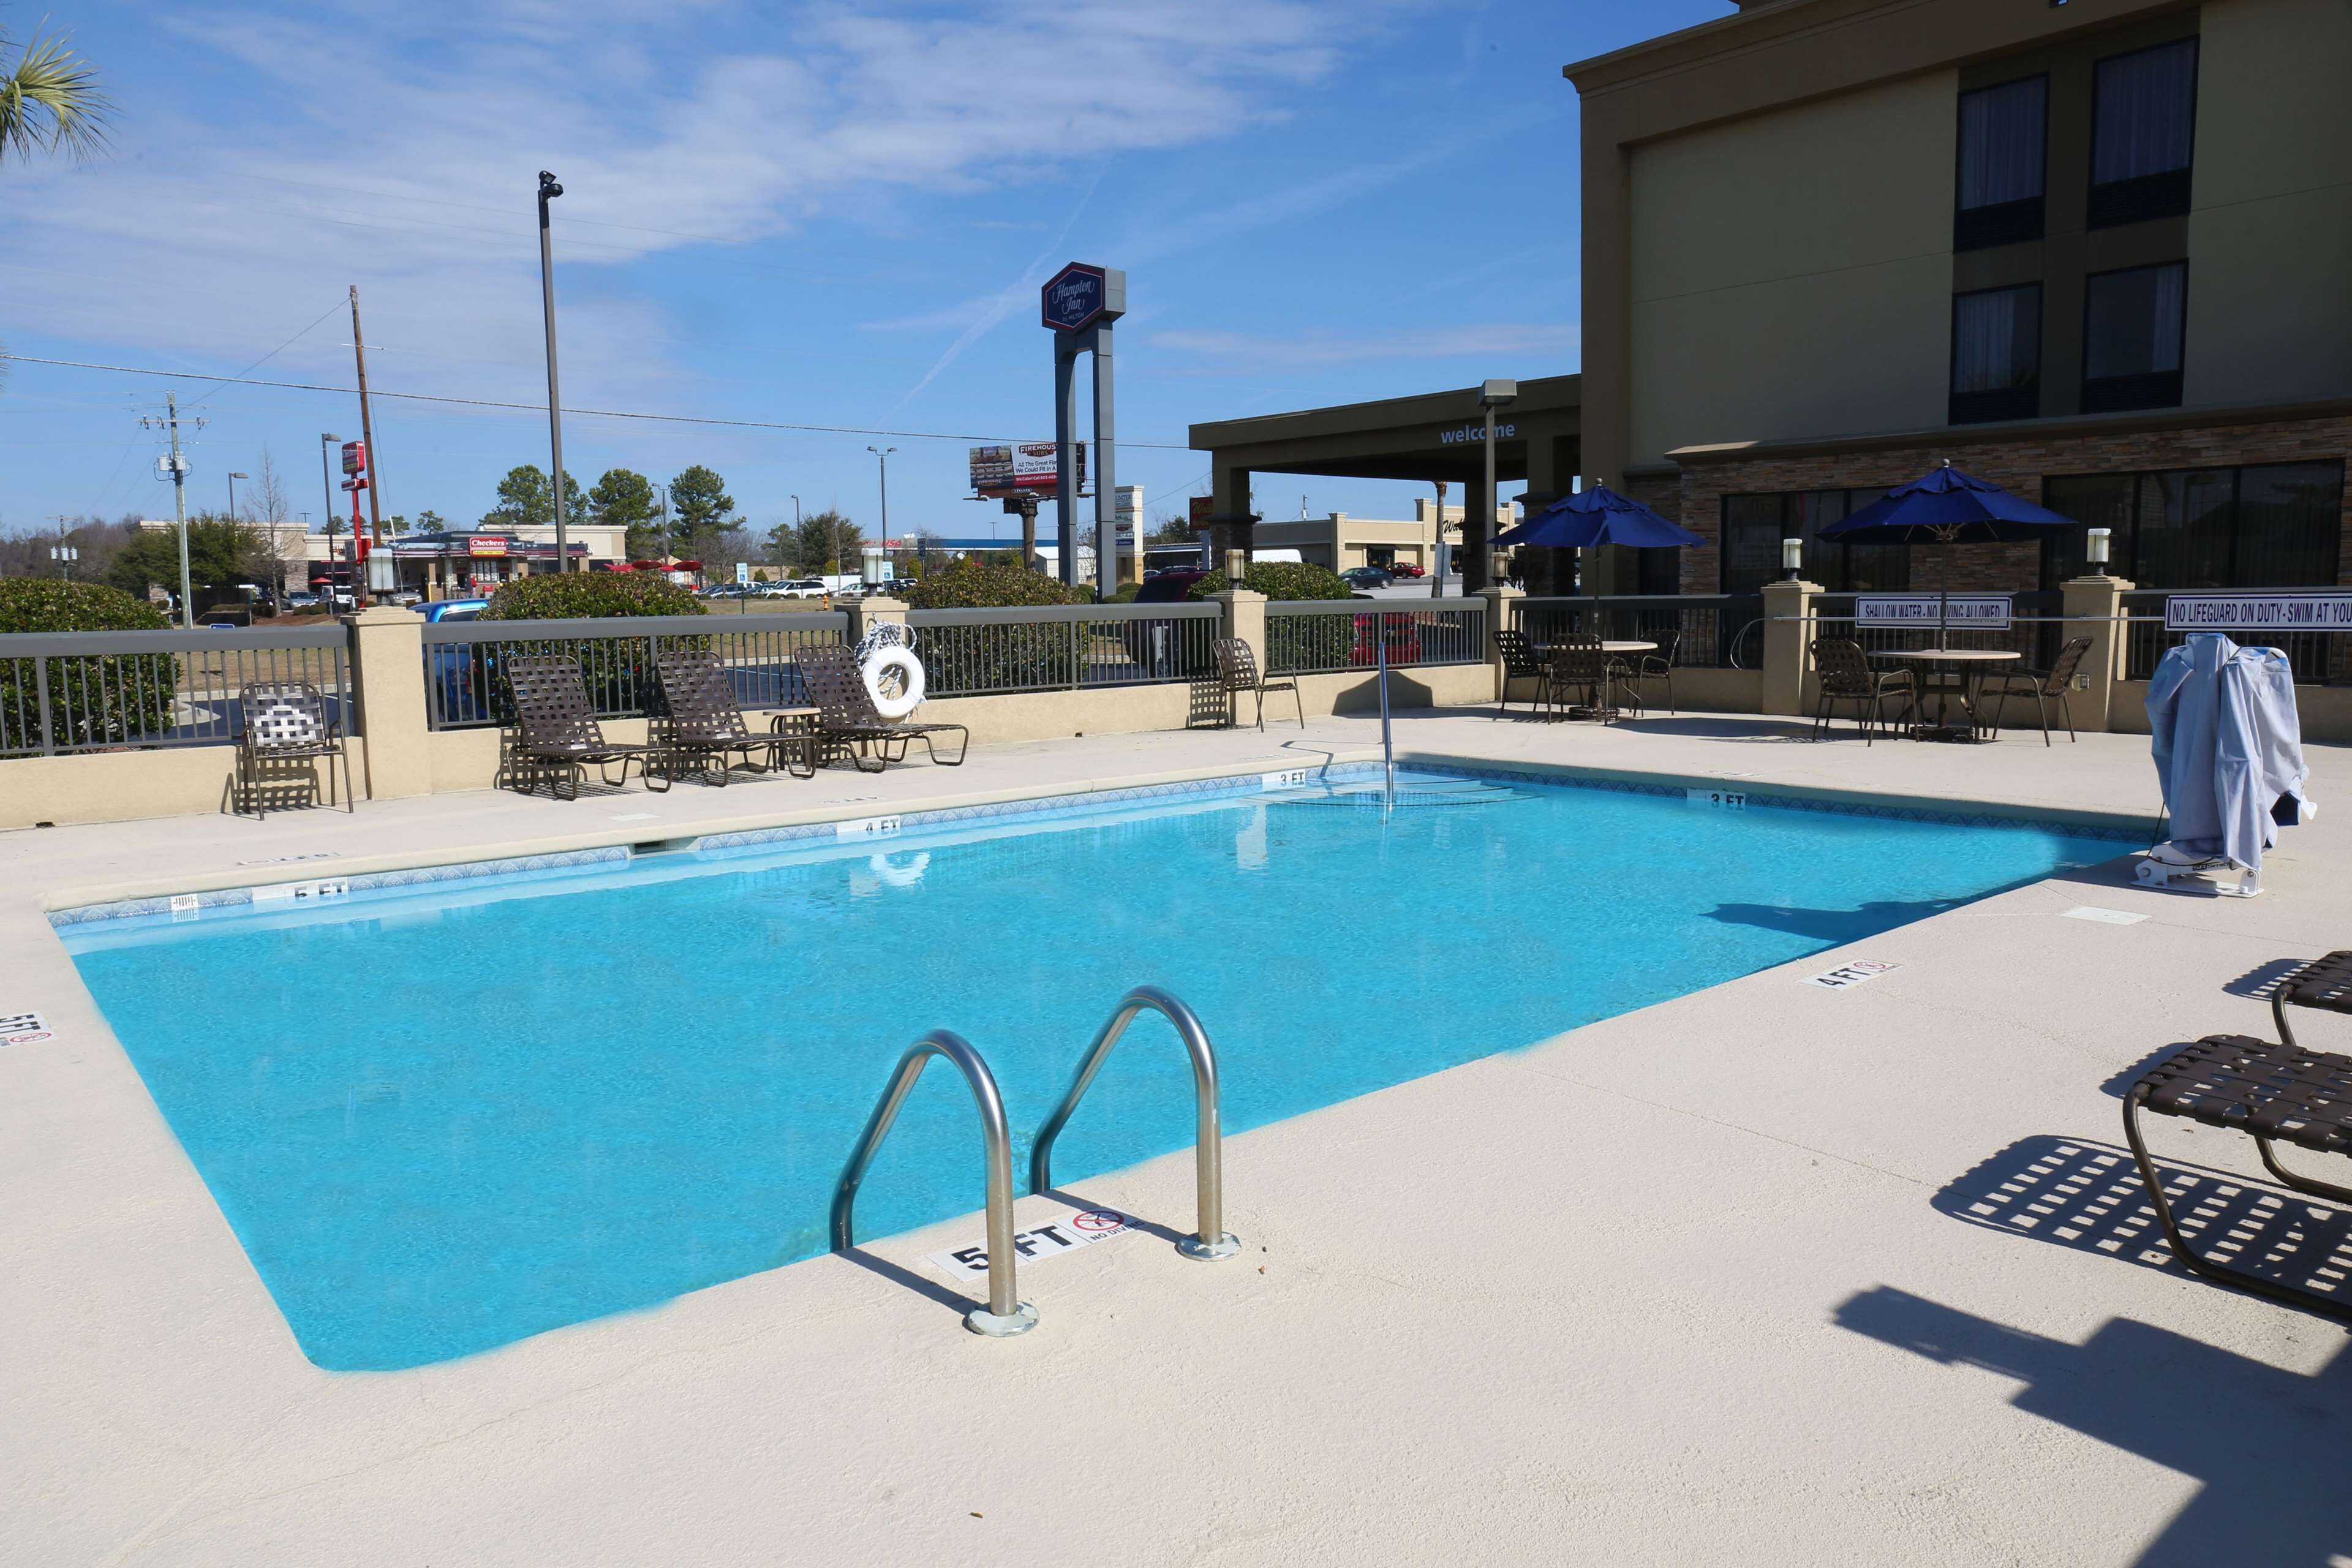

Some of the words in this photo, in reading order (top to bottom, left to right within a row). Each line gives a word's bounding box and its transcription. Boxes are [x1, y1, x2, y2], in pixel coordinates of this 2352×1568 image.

[1052, 280, 1095, 304] Hampton
[1062, 296, 1085, 314] Inn
[1020, 444, 1057, 454] FIREHOUS
[1927, 605, 1938, 621] NO
[2173, 603, 2185, 622] NO
[2188, 603, 2237, 622] LIFEGUARD
[2241, 603, 2255, 622] ON
[2316, 603, 2329, 622] AT
[1280, 774, 1286, 782] 3
[1291, 772, 1305, 782] FT
[1726, 794, 1744, 805] FT
[865, 822, 873, 831] 4
[881, 818, 899, 829] FT
[295, 886, 307, 898] 5
[1828, 967, 1872, 981] FT
[1817, 978, 1847, 986] 4
[1090, 1232, 1107, 1241] NO
[1107, 1221, 1145, 1234] DIVING
[951, 1246, 989, 1270] 5
[1014, 1225, 1073, 1257] FT
